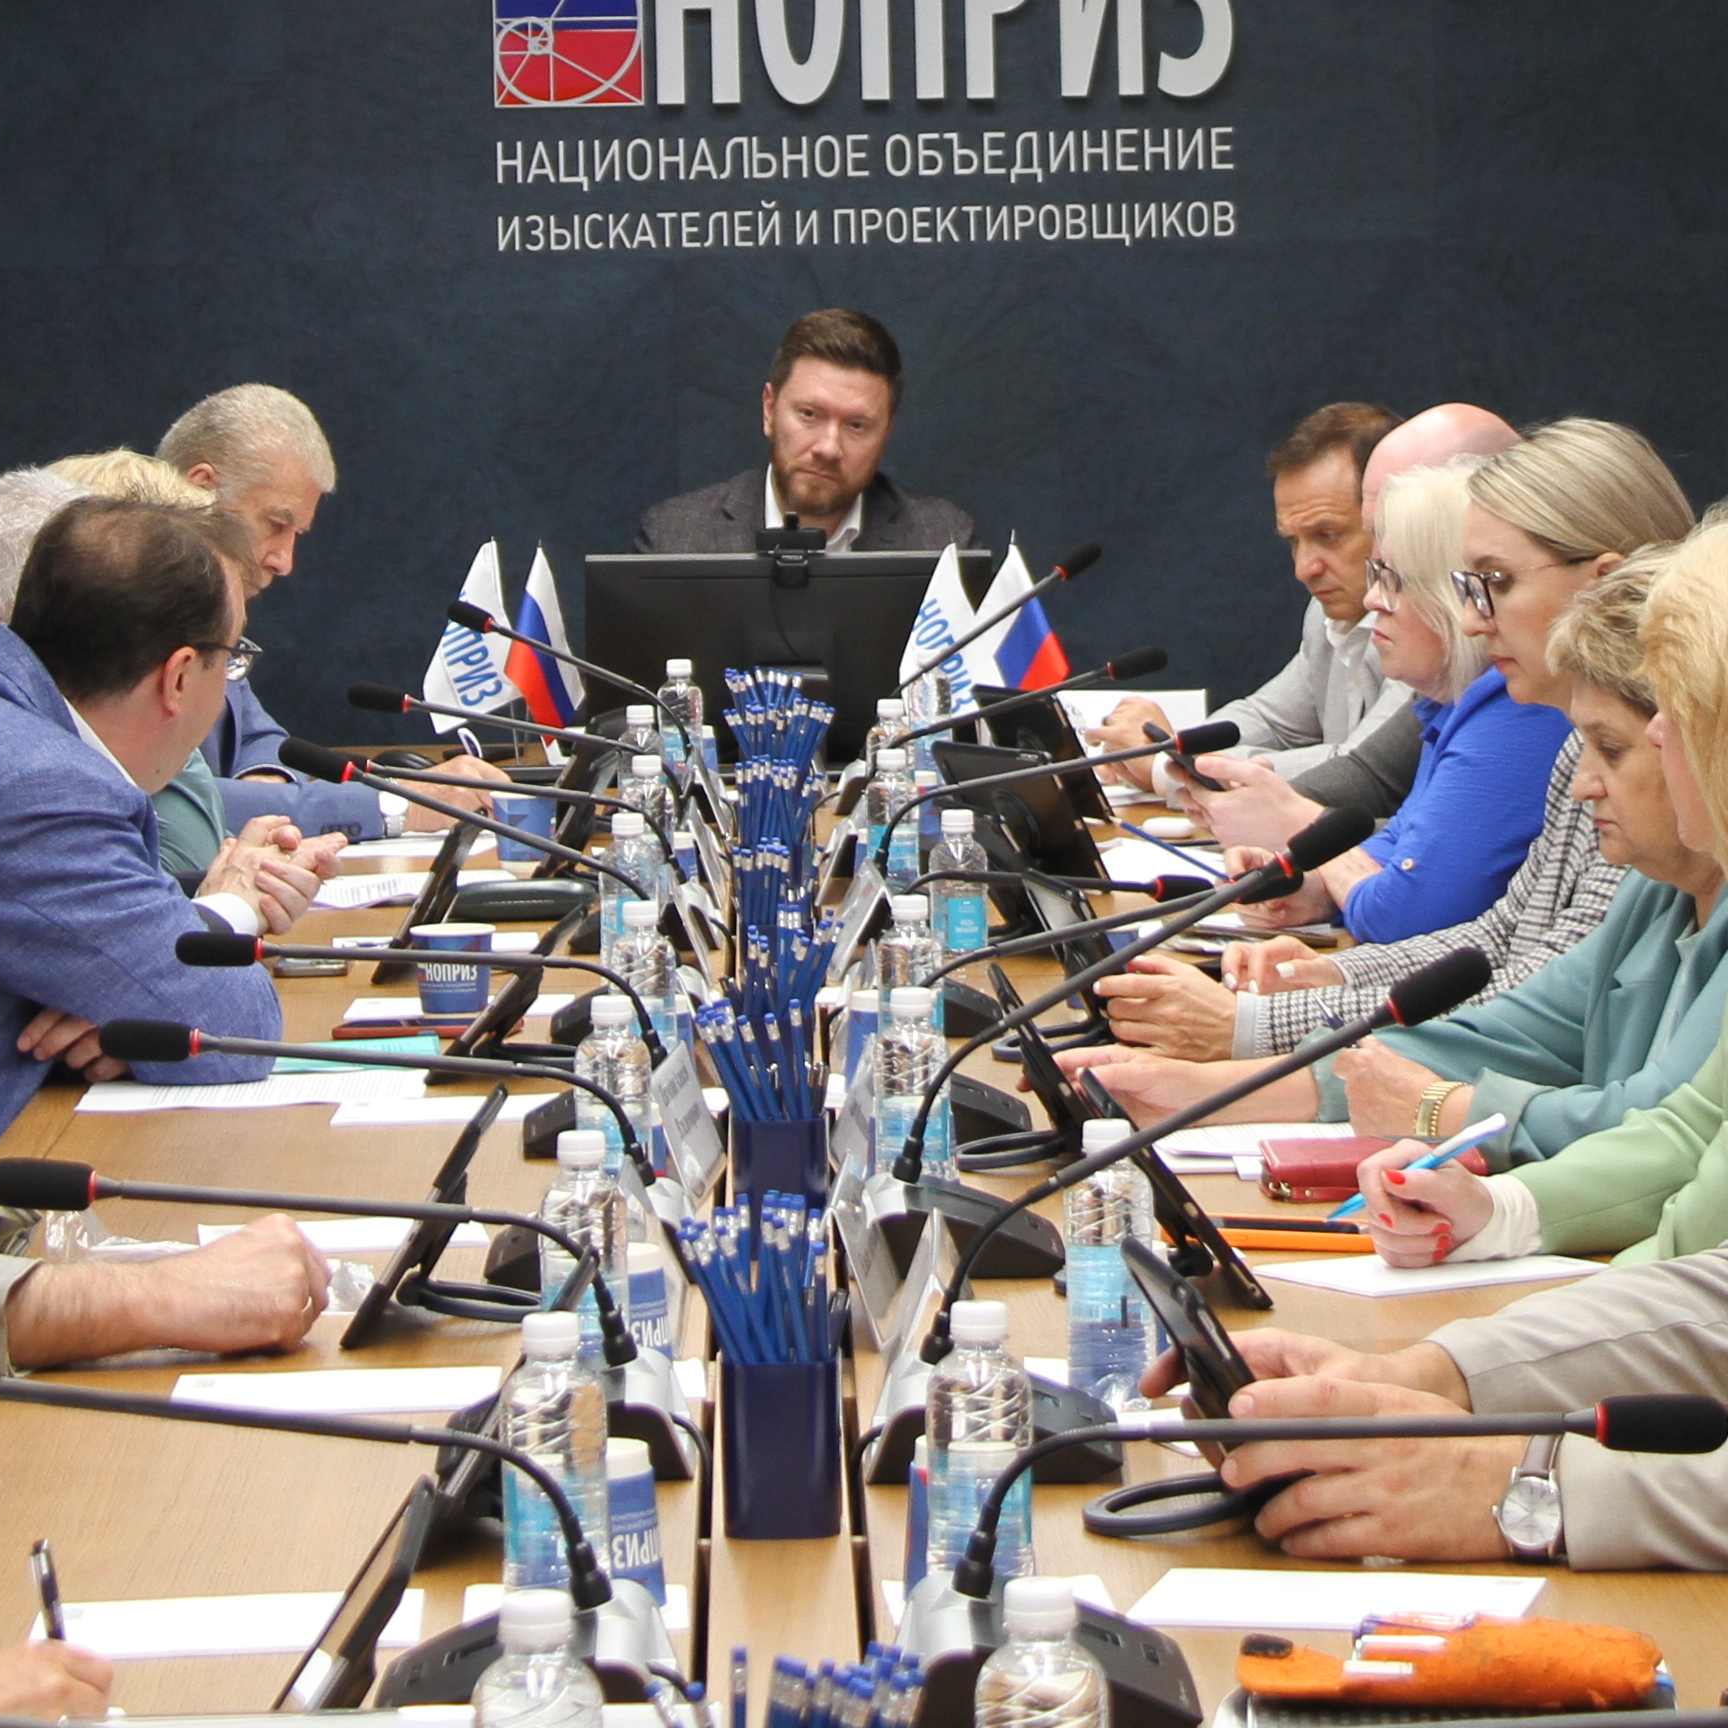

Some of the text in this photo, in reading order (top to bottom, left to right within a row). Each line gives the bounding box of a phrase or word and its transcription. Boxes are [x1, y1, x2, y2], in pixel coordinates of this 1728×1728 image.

[495, 126, 1235, 193] НАЦИОНАЛЬНОЕ ОБЪЕДИНЕНИЕ
[496, 199, 1237, 253] ИЗЫСКАТЕЛЕЙ И ПРОЕКТИРОВЩИКОВ
[441, 590, 503, 706] ПРИЗ
[425, 963, 478, 982] НОПРИЗ
